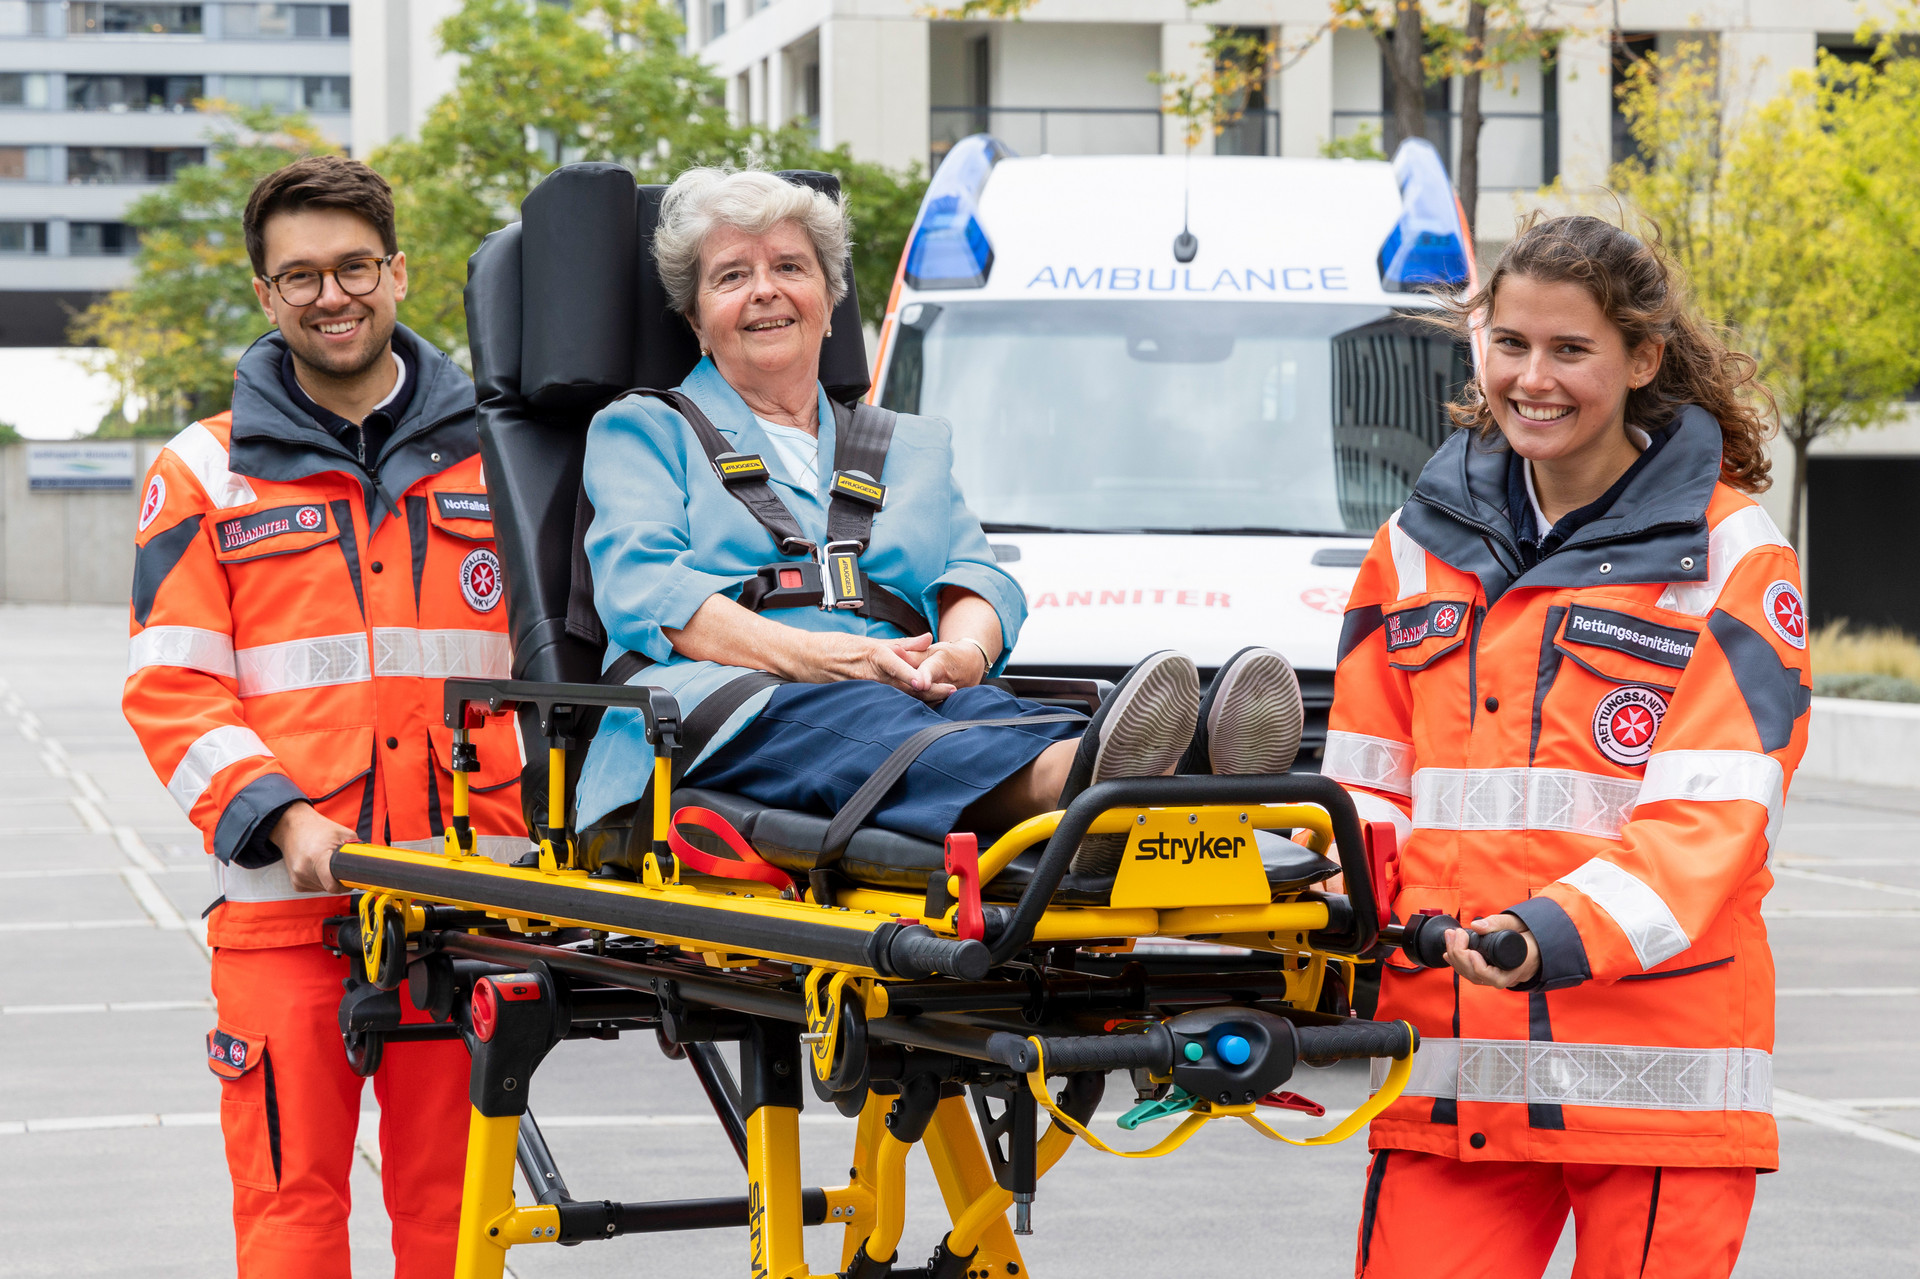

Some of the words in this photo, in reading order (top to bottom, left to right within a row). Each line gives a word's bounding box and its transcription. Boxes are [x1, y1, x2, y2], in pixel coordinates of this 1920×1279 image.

[1027, 266, 1349, 291] AMBULANCE
[844, 481, 875, 494] RUGGED
[223, 521, 242, 535] DIE
[225, 519, 290, 548] JOHANNITER
[843, 564, 852, 592] RUGGED
[473, 597, 489, 607] NKV
[1027, 588, 1231, 608] ANNITER
[1572, 616, 1694, 657] Rettungssanitäterin
[1135, 831, 1246, 864] stryker
[749, 1181, 767, 1279] stry
